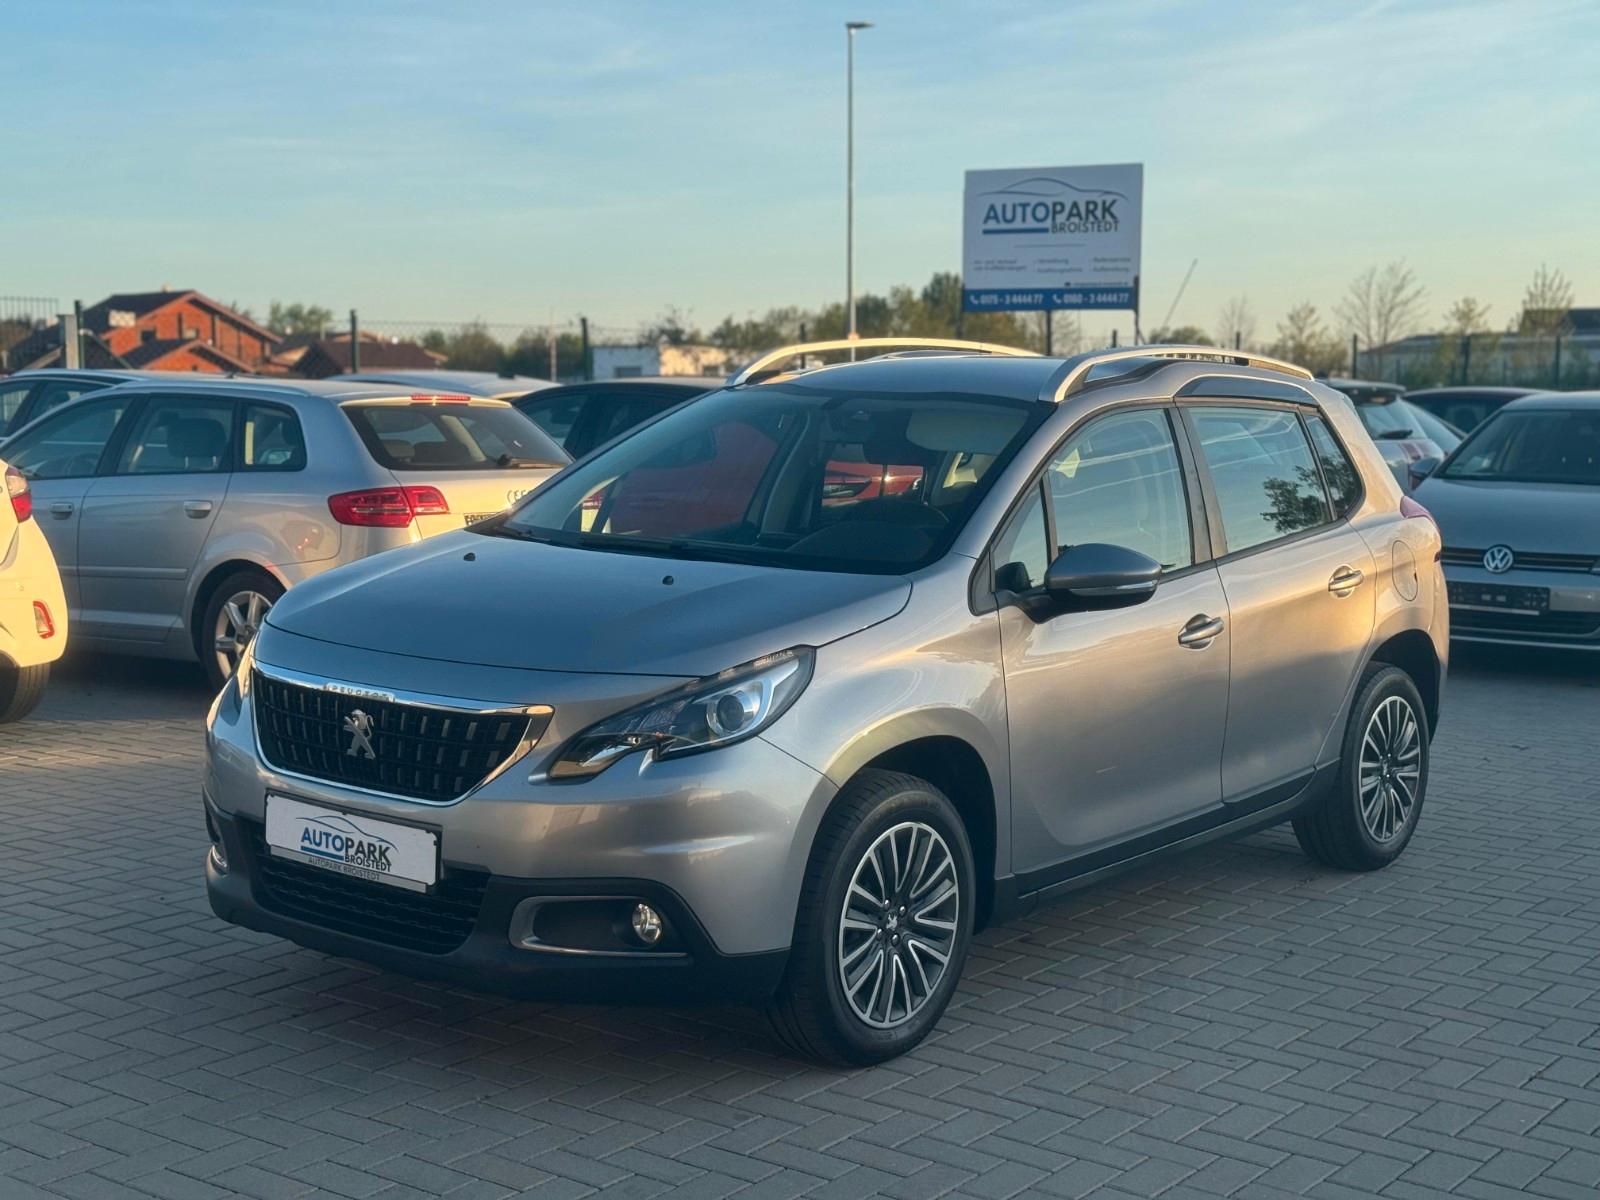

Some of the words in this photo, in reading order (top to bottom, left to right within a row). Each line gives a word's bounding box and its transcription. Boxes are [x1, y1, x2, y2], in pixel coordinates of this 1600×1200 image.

[983, 199, 1118, 224] AUTOPARK
[1051, 220, 1120, 233] BROISTEDT
[301, 827, 391, 864] AUTOPARK
[308, 857, 342, 872] AUTOPARK
[343, 865, 381, 880] BROISTEDT
[344, 853, 392, 872] BROISTEDT
